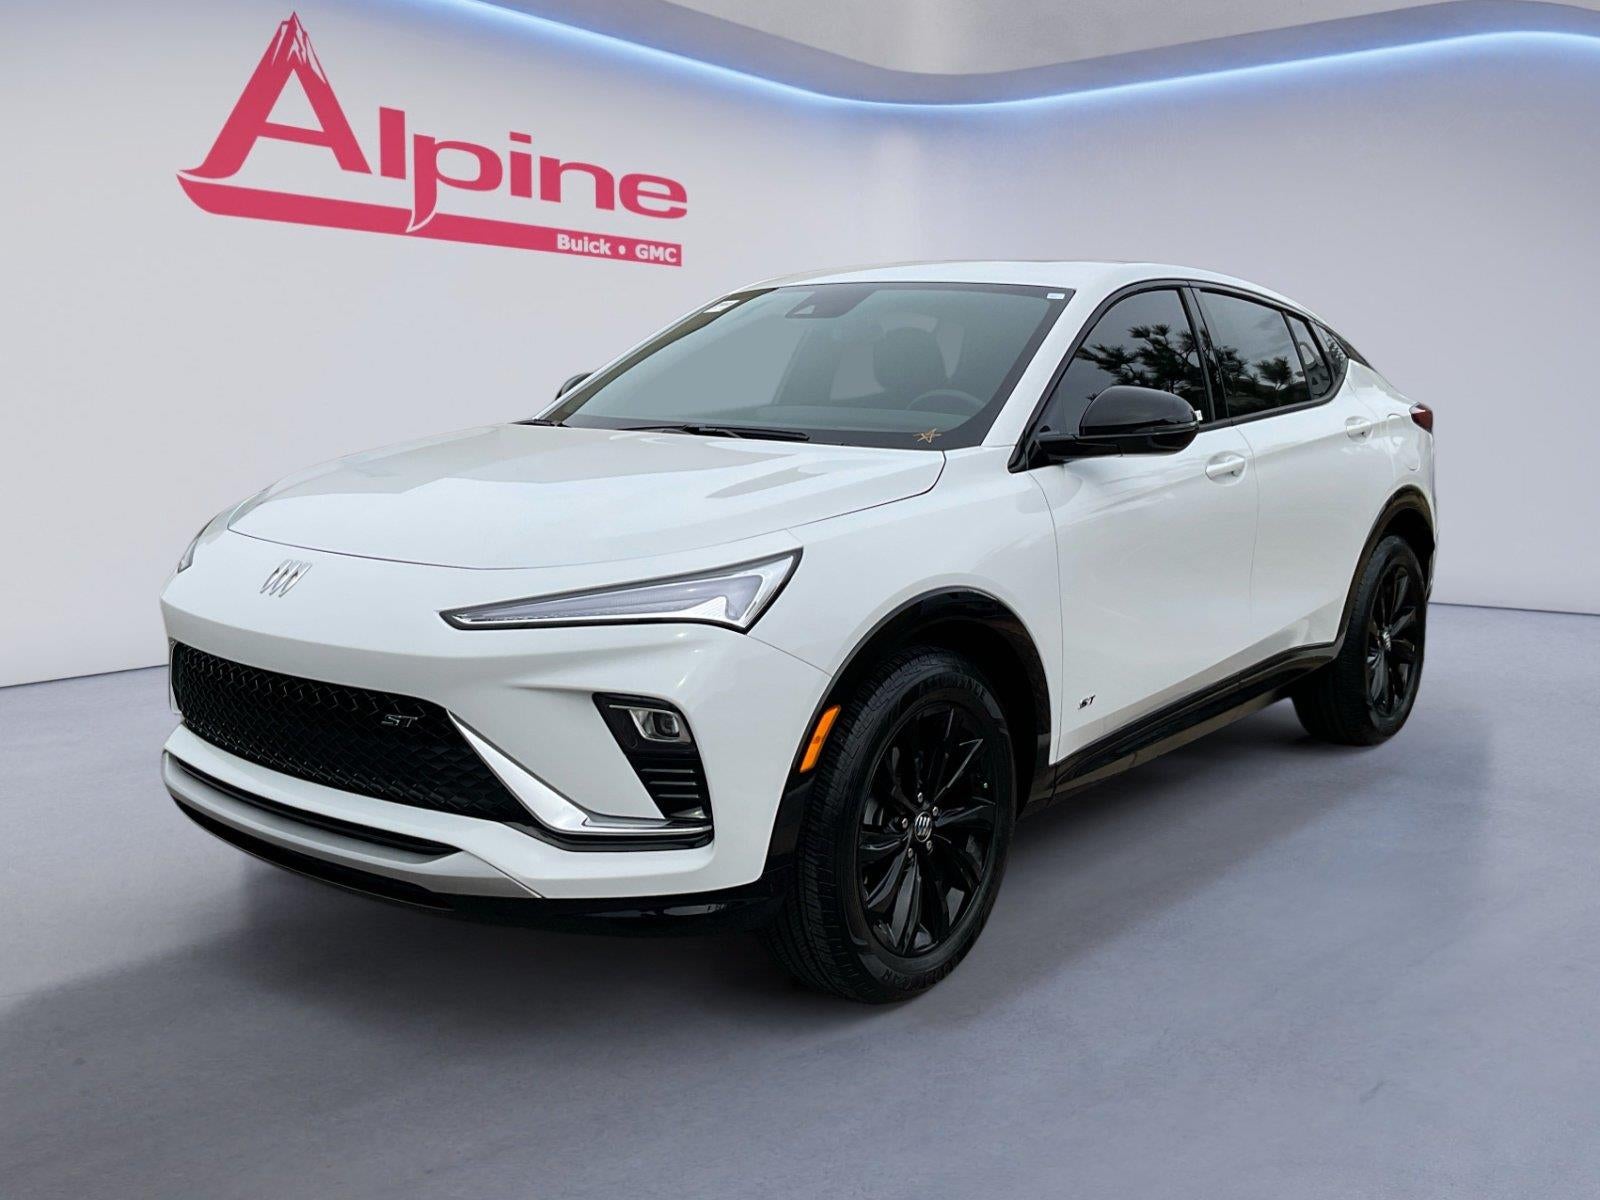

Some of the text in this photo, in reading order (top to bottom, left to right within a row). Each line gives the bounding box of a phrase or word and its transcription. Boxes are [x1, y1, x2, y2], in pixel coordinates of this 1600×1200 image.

[178, 11, 688, 233] Alpine
[557, 233, 678, 263] Buick GMC
[381, 713, 419, 728] ST
